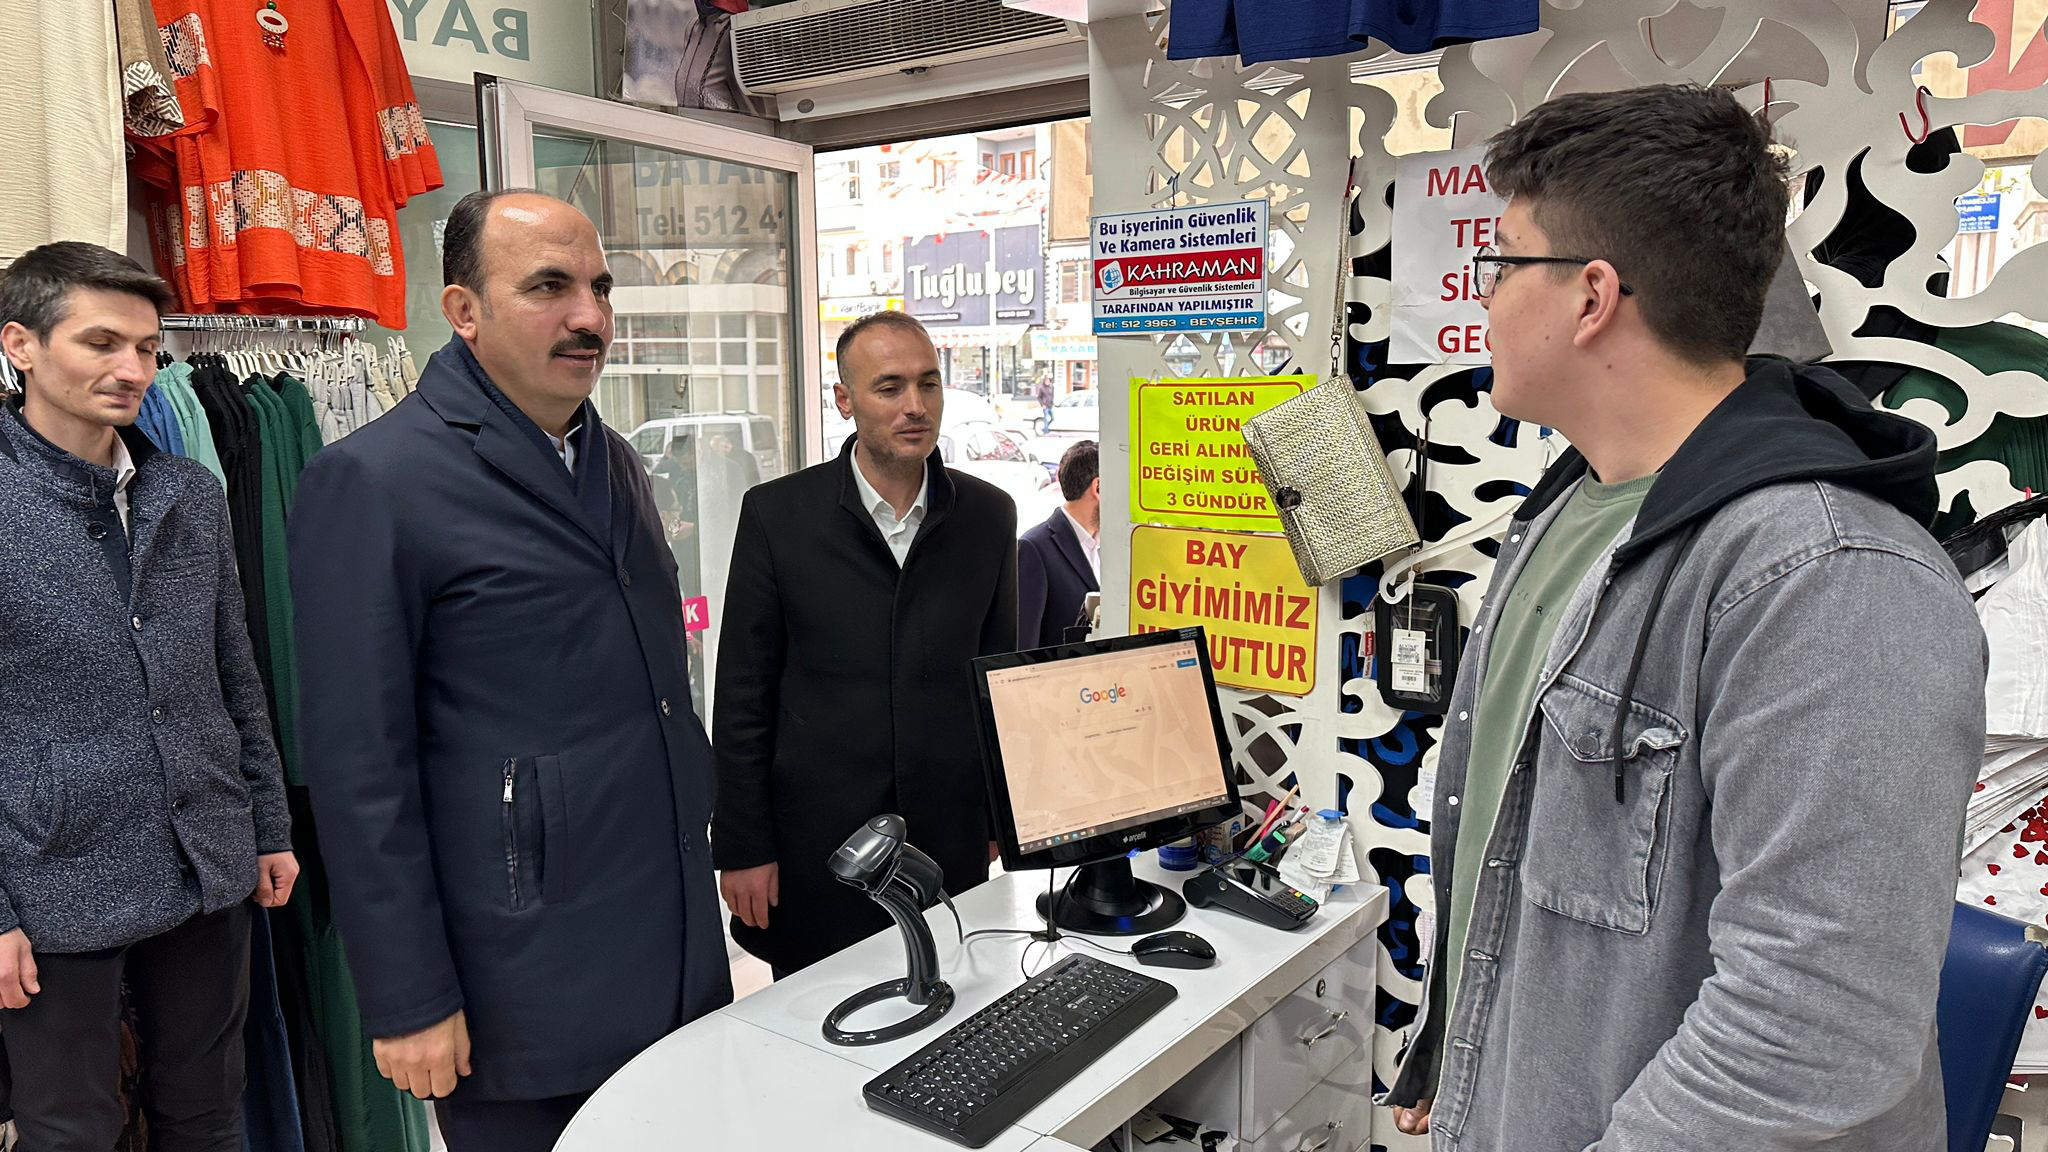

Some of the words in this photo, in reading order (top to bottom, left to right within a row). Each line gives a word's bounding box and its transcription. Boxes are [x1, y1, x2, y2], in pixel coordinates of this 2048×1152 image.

[1427, 164, 1487, 196] MA
[638, 206, 685, 236] Tel:
[694, 204, 749, 236] 512
[759, 204, 784, 233] 4
[1100, 221, 1117, 236] Bu
[1121, 214, 1184, 237] işyerinin
[1188, 207, 1257, 228] Güvenlik
[1099, 241, 1117, 254] Ve
[1120, 237, 1175, 253] Kamera
[1180, 227, 1256, 248] Sistemleri
[1127, 256, 1257, 282] KAHRAMAN
[1129, 287, 1166, 298] Bilgisayar
[1178, 284, 1213, 294] Güvenlik
[1214, 281, 1255, 292] Sistemleri
[1440, 264, 1480, 301] Sİ
[1102, 301, 1174, 315] TARAFINDAN
[1178, 298, 1254, 313] YAPILMIŞTIR
[1099, 321, 1118, 329] Tel:
[1121, 320, 1141, 328] 512
[1144, 319, 1177, 328] 3963
[1173, 391, 1255, 406] SATILAN
[1186, 414, 1241, 432] ÜRÜN
[1150, 440, 1190, 457] GERİ
[1142, 465, 1215, 485] DEĞİŞİM
[1221, 467, 1264, 484] SÜR
[1167, 492, 1177, 506] 3
[1183, 492, 1267, 510] GÜNDÜR
[1186, 539, 1248, 569] BAY
[1136, 573, 1311, 630] GİYİMİMİZ
[685, 603, 700, 624] K
[1079, 683, 1127, 704] Google
